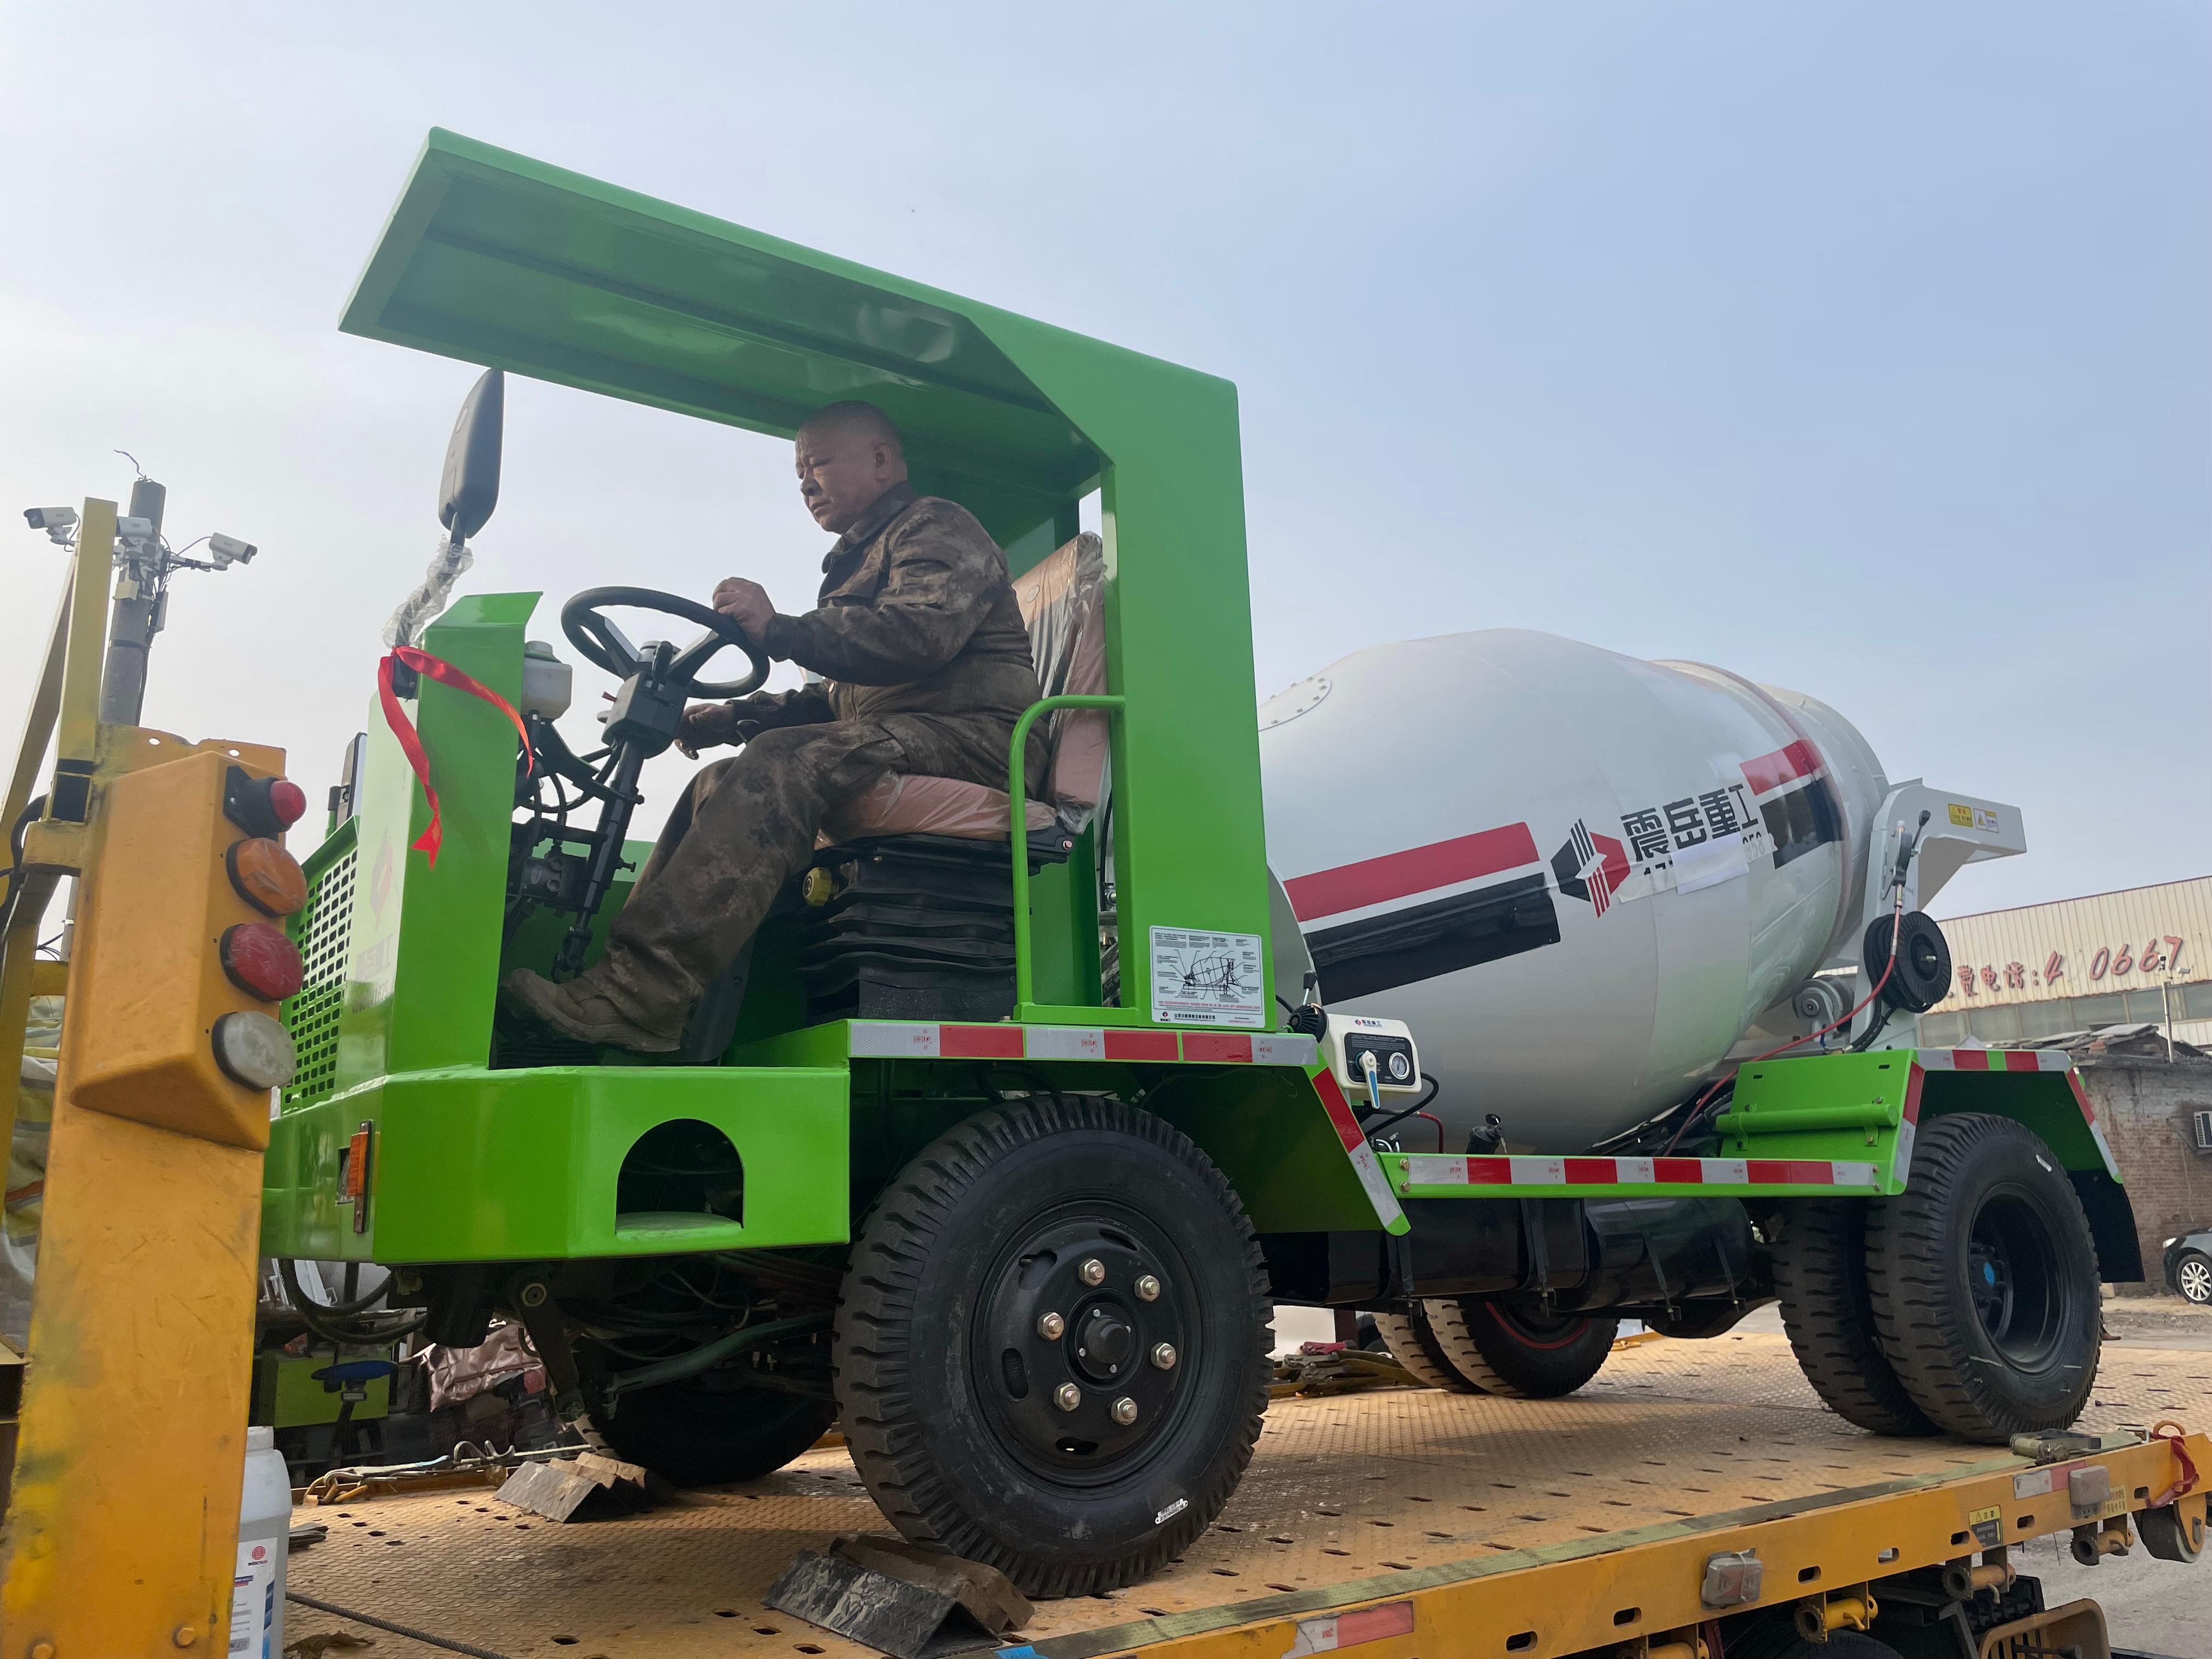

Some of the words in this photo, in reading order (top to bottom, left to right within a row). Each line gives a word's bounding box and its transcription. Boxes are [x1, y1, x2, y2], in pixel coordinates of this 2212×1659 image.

[1620, 783, 1759, 862] 震岳重工
[2089, 935, 2183, 981] 0667
